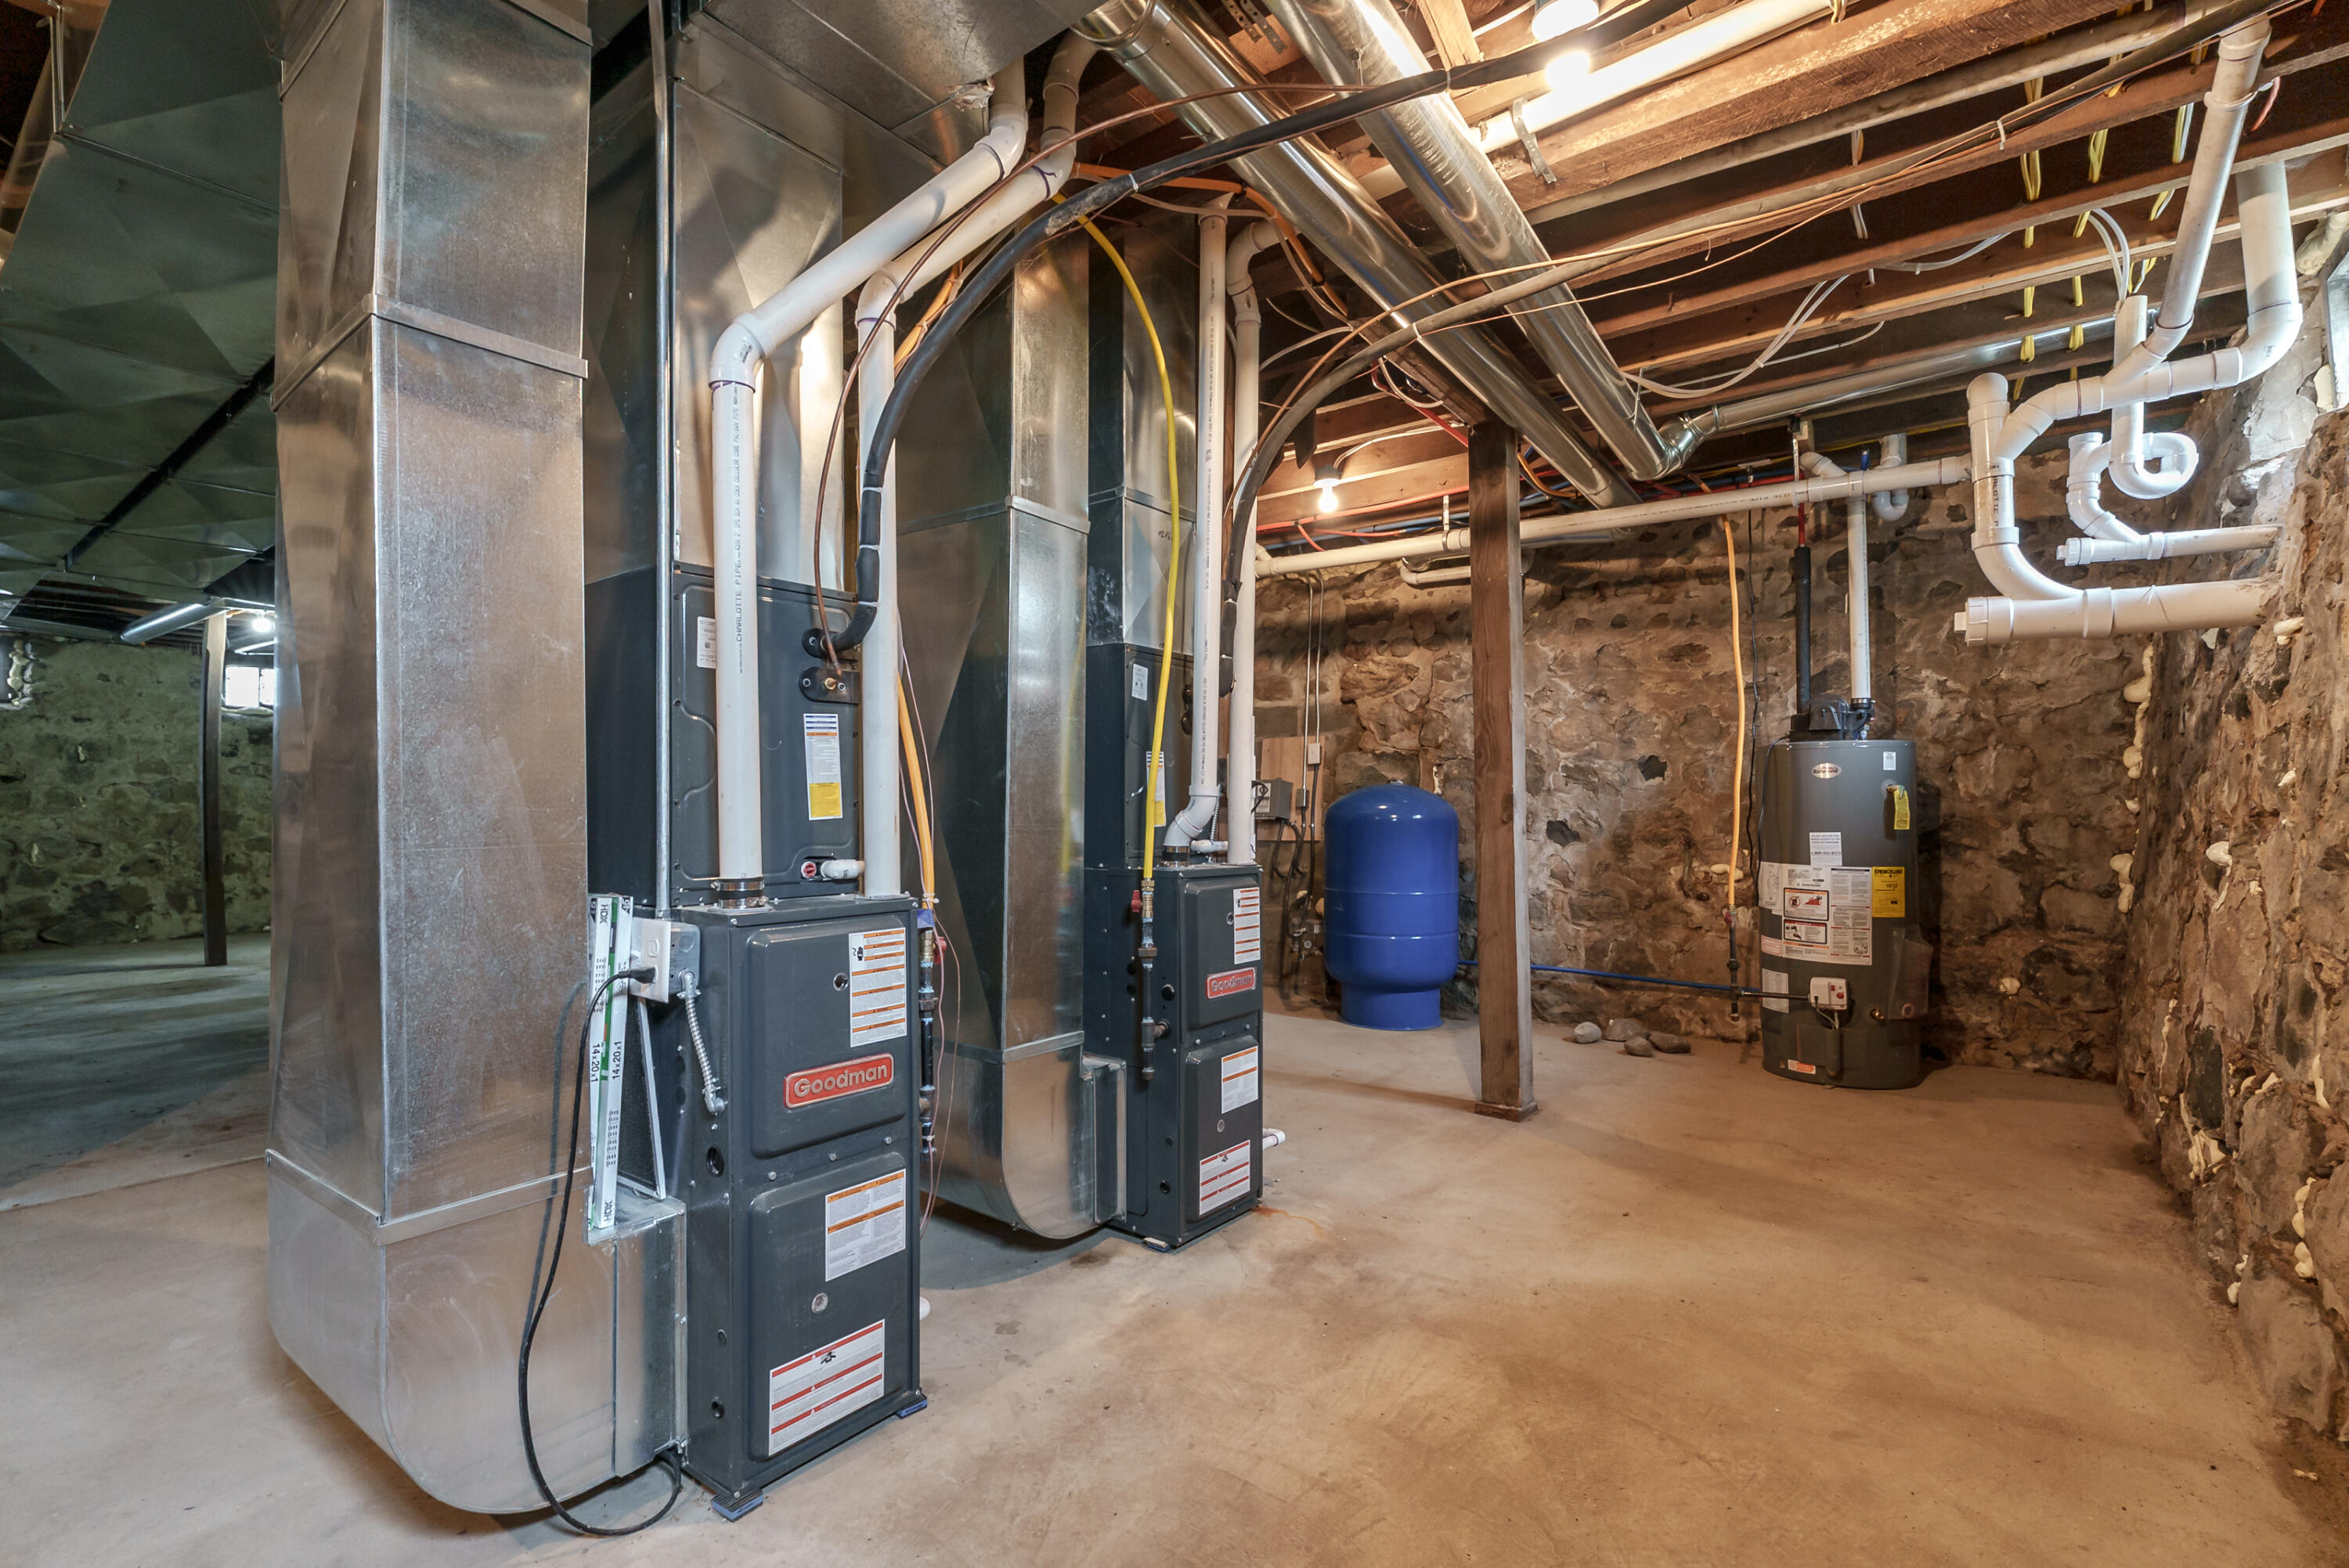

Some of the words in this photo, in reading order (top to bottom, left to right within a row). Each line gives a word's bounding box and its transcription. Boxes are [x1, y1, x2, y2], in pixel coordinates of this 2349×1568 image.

[600, 904, 608, 924] HDX
[1211, 974, 1253, 993] Goodman
[793, 1064, 888, 1098] Goodman
[603, 1199, 613, 1222] HDX
